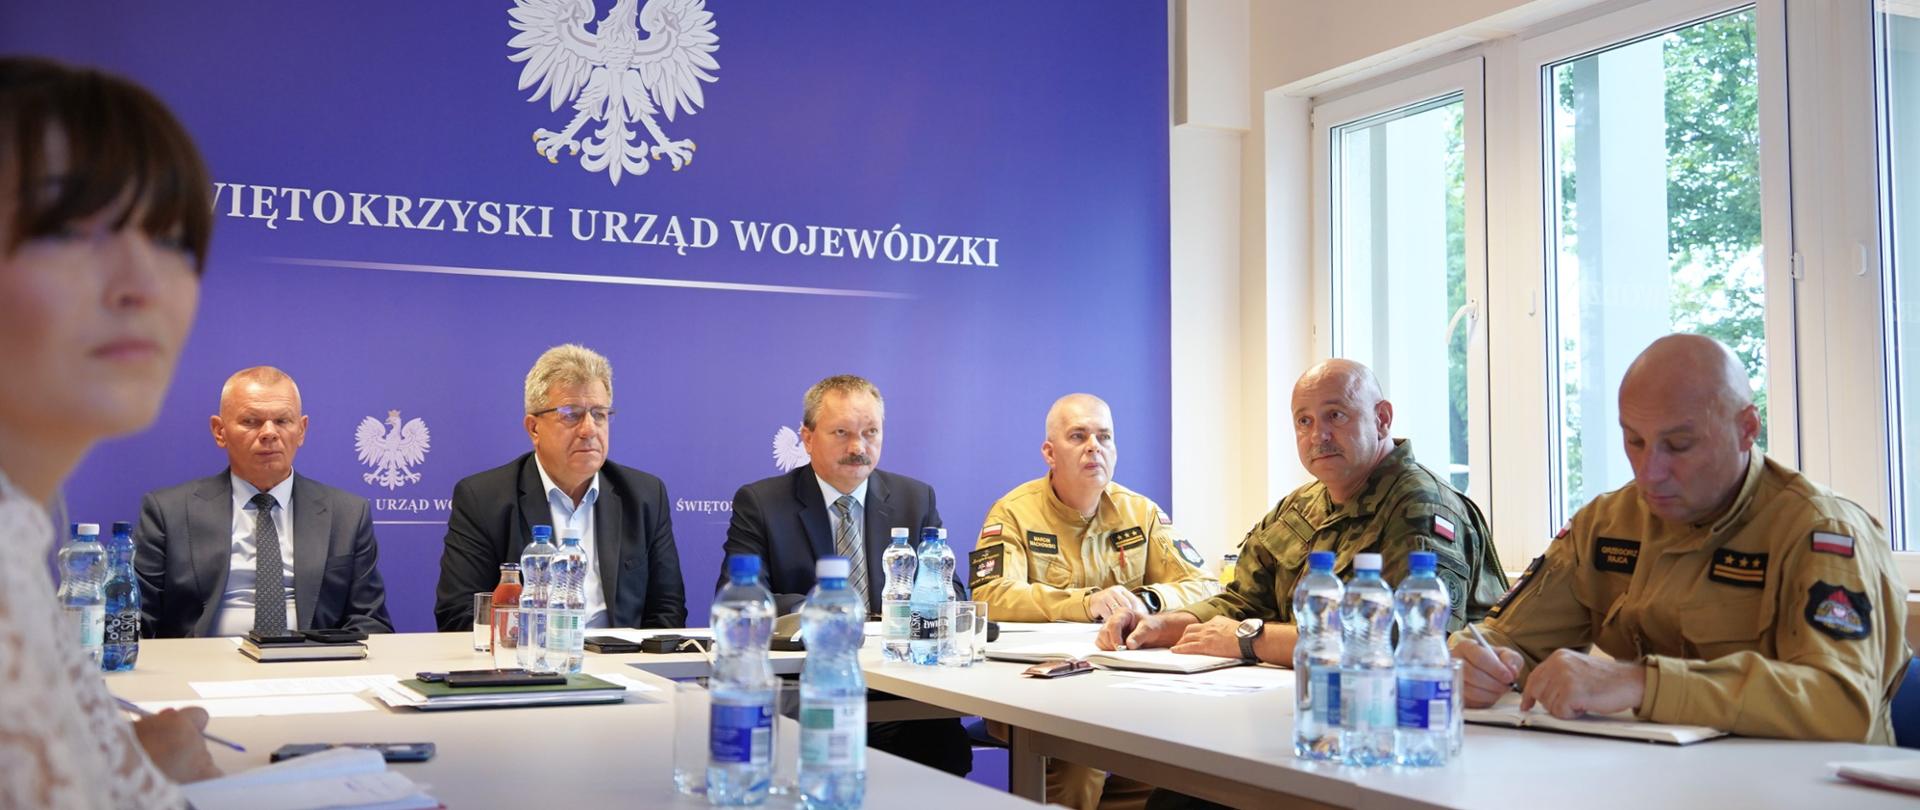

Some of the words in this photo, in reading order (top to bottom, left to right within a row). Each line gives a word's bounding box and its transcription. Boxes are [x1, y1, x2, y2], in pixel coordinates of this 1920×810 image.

[211, 182, 554, 238] IĘTOKRZYSKI
[568, 207, 719, 256] URZĄD
[730, 219, 999, 268] WOJEWÓDZKI
[376, 498, 430, 514] URZĄD
